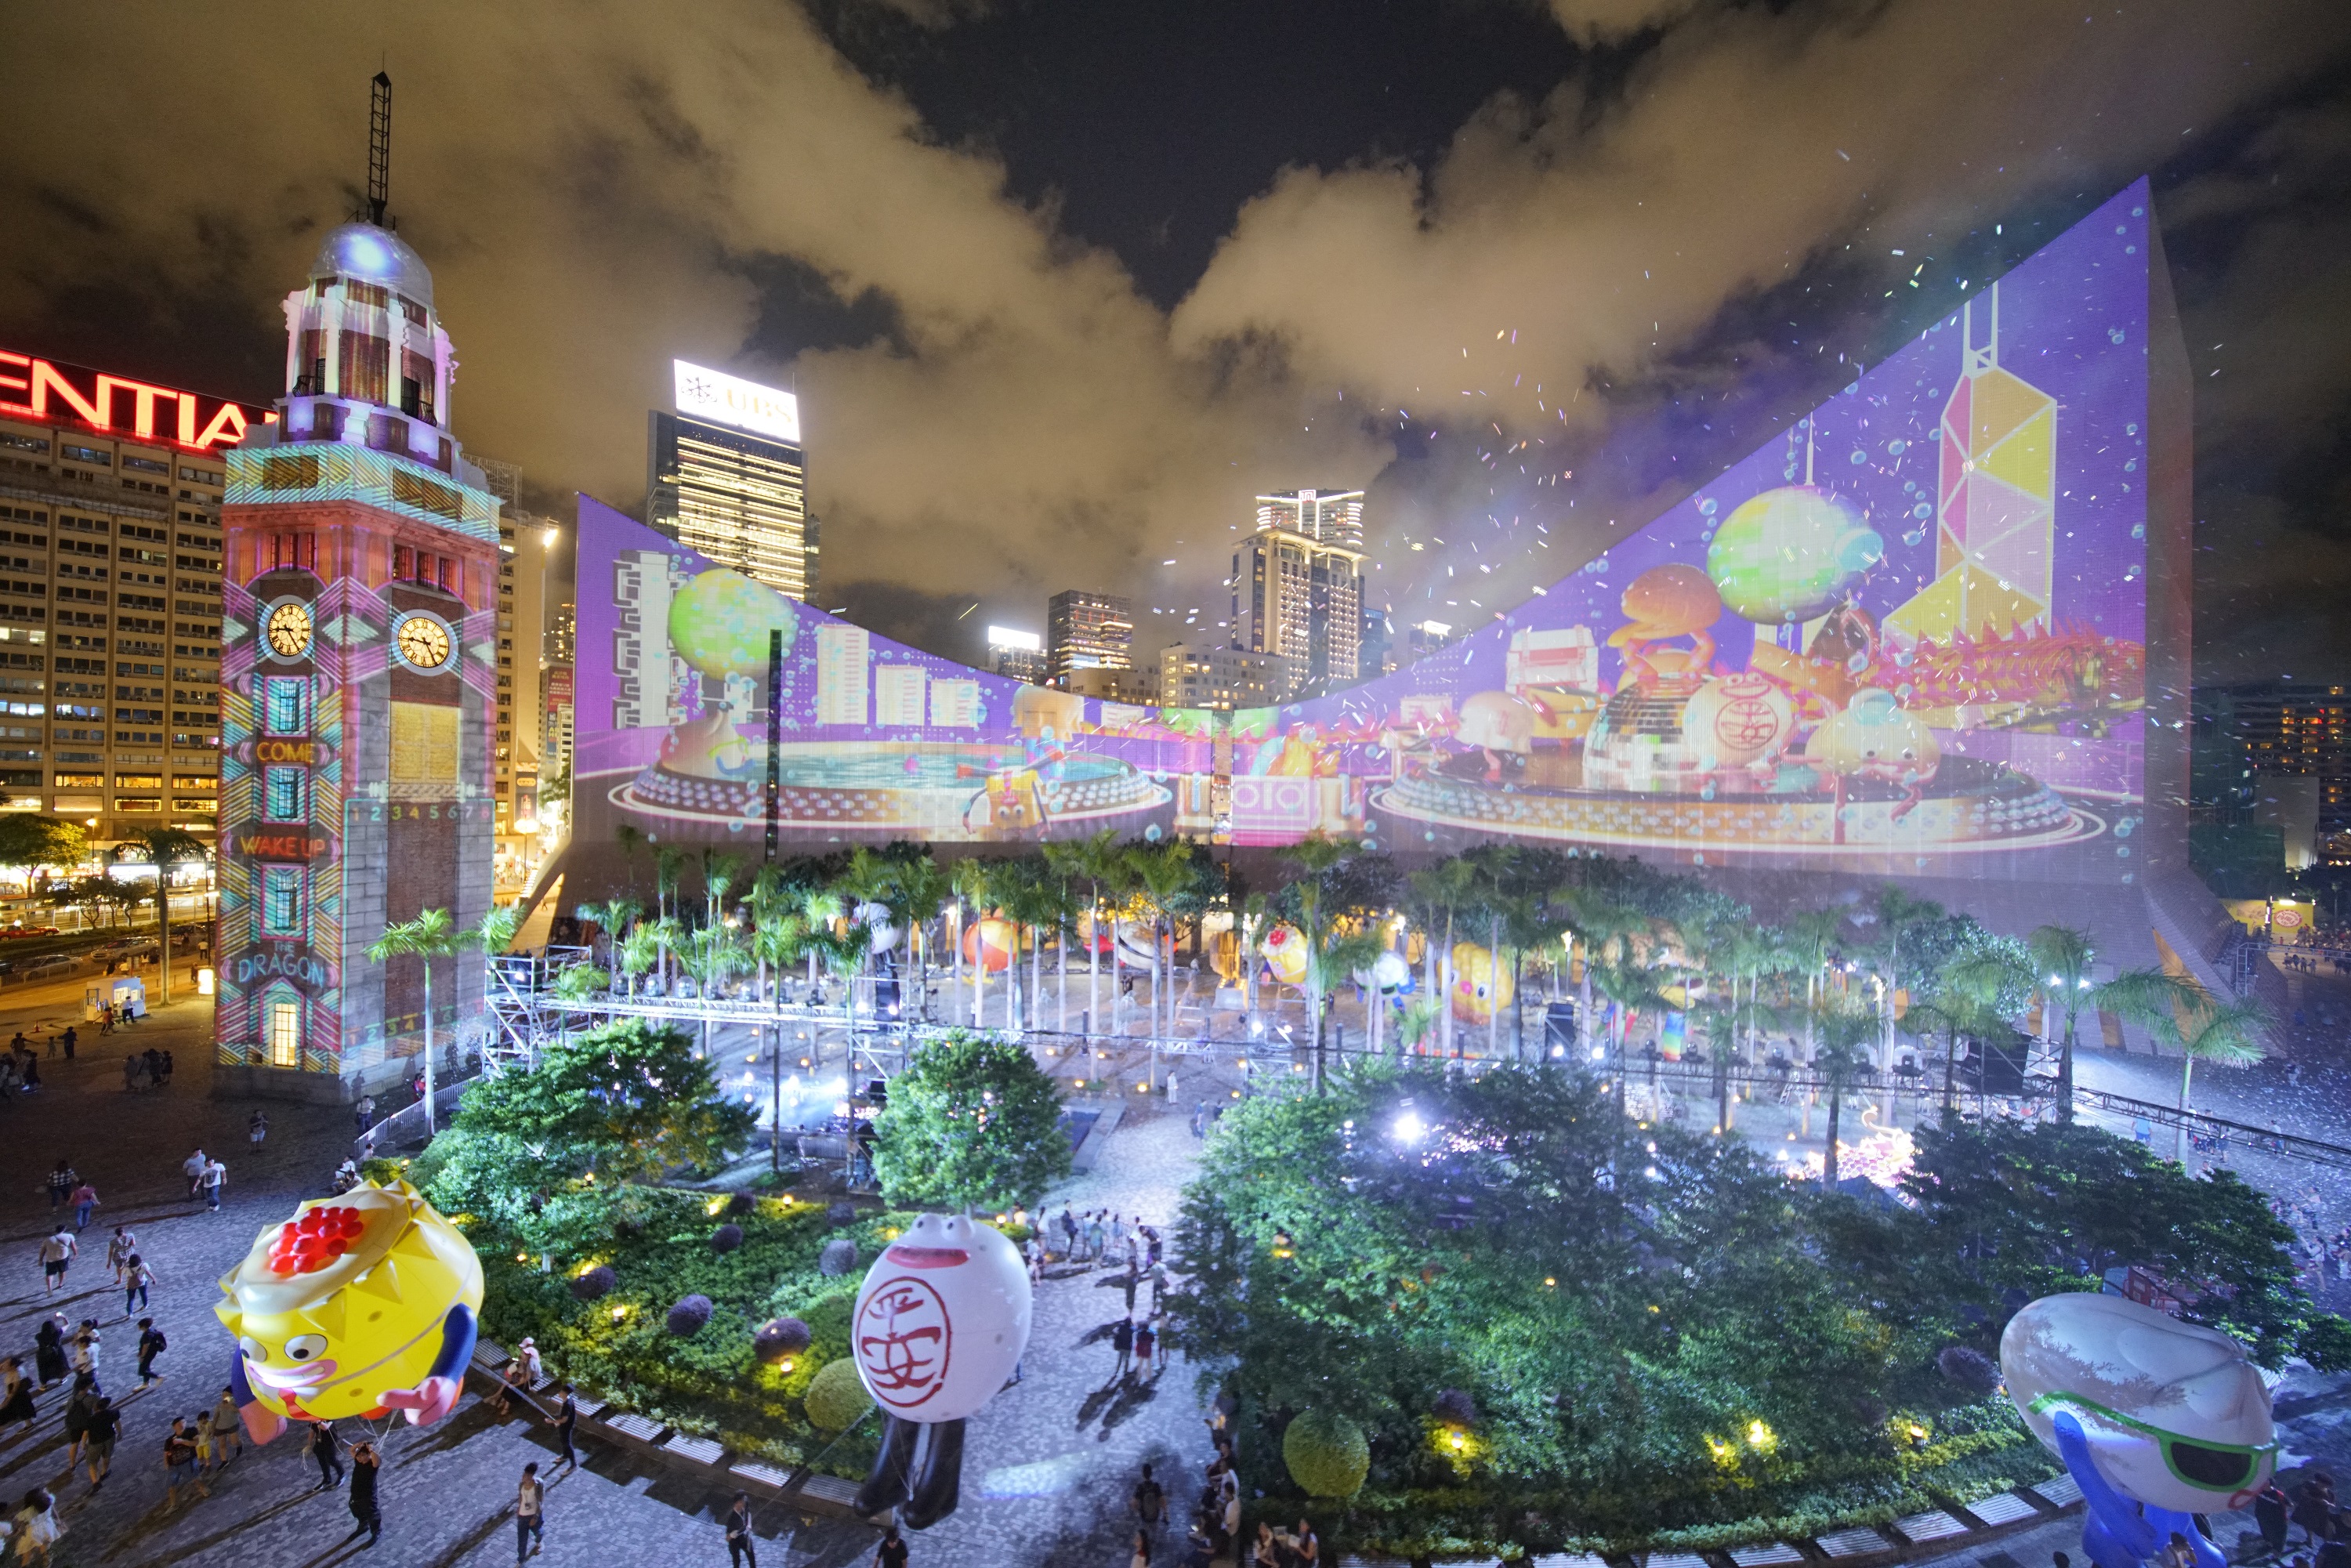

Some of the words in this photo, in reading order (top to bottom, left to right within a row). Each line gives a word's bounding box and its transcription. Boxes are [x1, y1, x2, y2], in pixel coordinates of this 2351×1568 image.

[0, 350, 279, 449] ENTIA
[726, 388, 792, 424] UBS
[256, 741, 315, 763] COME
[370, 806, 382, 822] 2
[392, 806, 402, 820] 3
[409, 806, 419, 820] 4
[429, 805, 440, 820] 5
[447, 805, 458, 820] 6
[240, 835, 297, 857] WAKE
[301, 838, 326, 859] UP
[274, 940, 295, 953] THE
[238, 952, 324, 989] DRAGON
